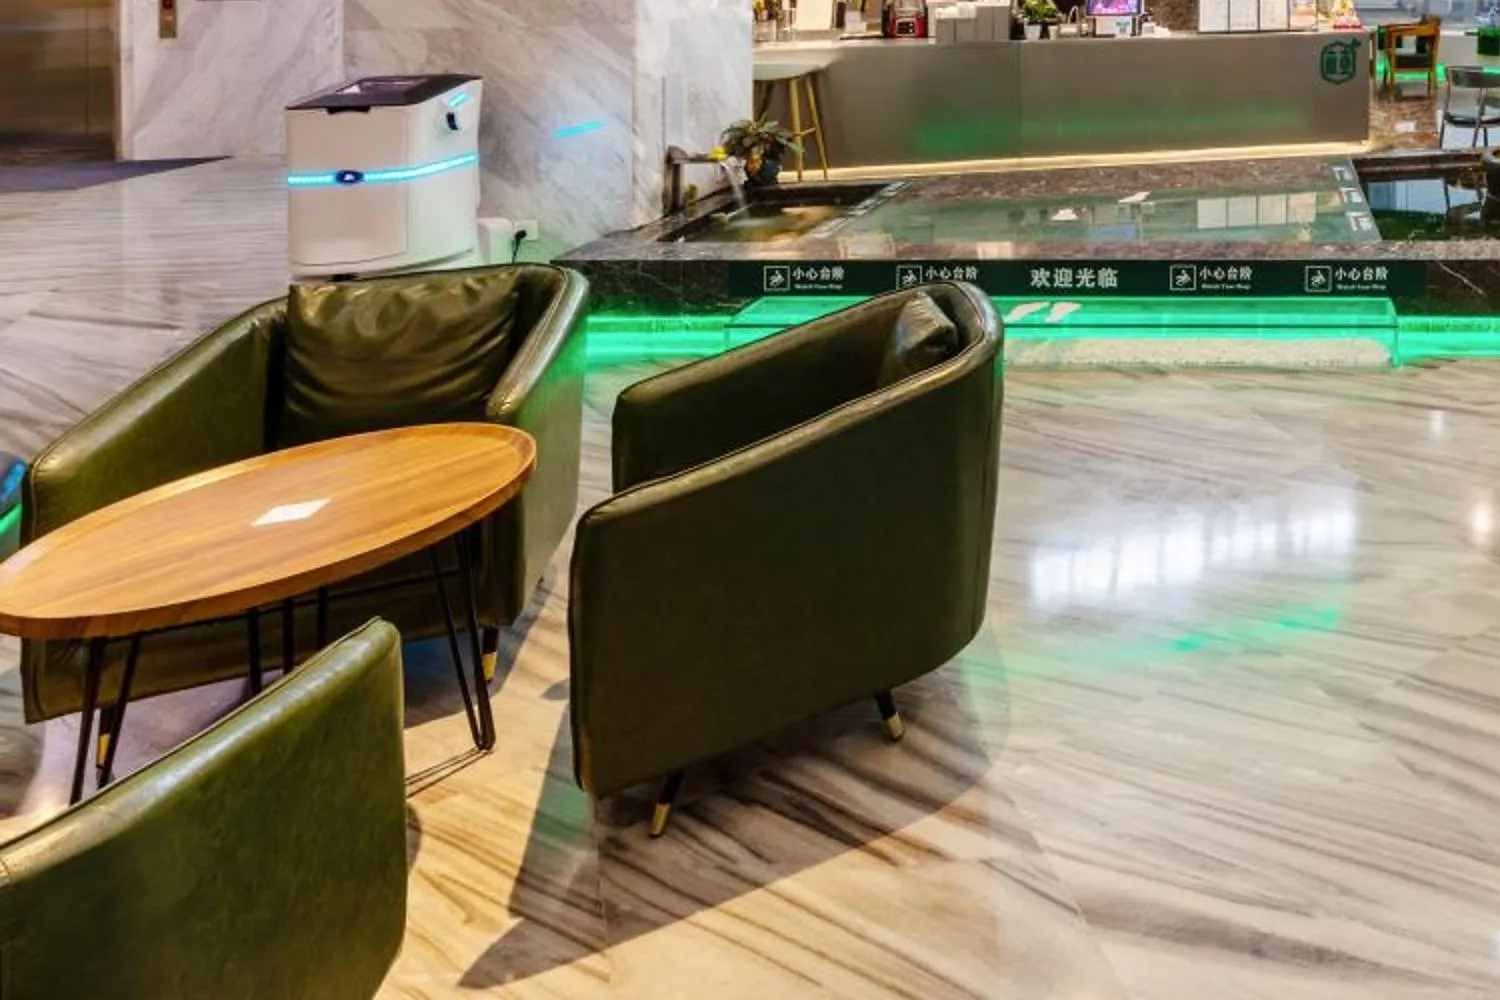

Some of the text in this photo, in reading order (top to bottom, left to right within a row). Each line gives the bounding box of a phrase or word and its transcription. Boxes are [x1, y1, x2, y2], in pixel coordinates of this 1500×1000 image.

[792, 266, 845, 281] 小心台阶
[925, 266, 977, 281] 小心台阶
[1030, 267, 1118, 288] 欢迎光临
[1200, 266, 1252, 281] 小心台阶
[1335, 266, 1388, 281] 小心台阶
